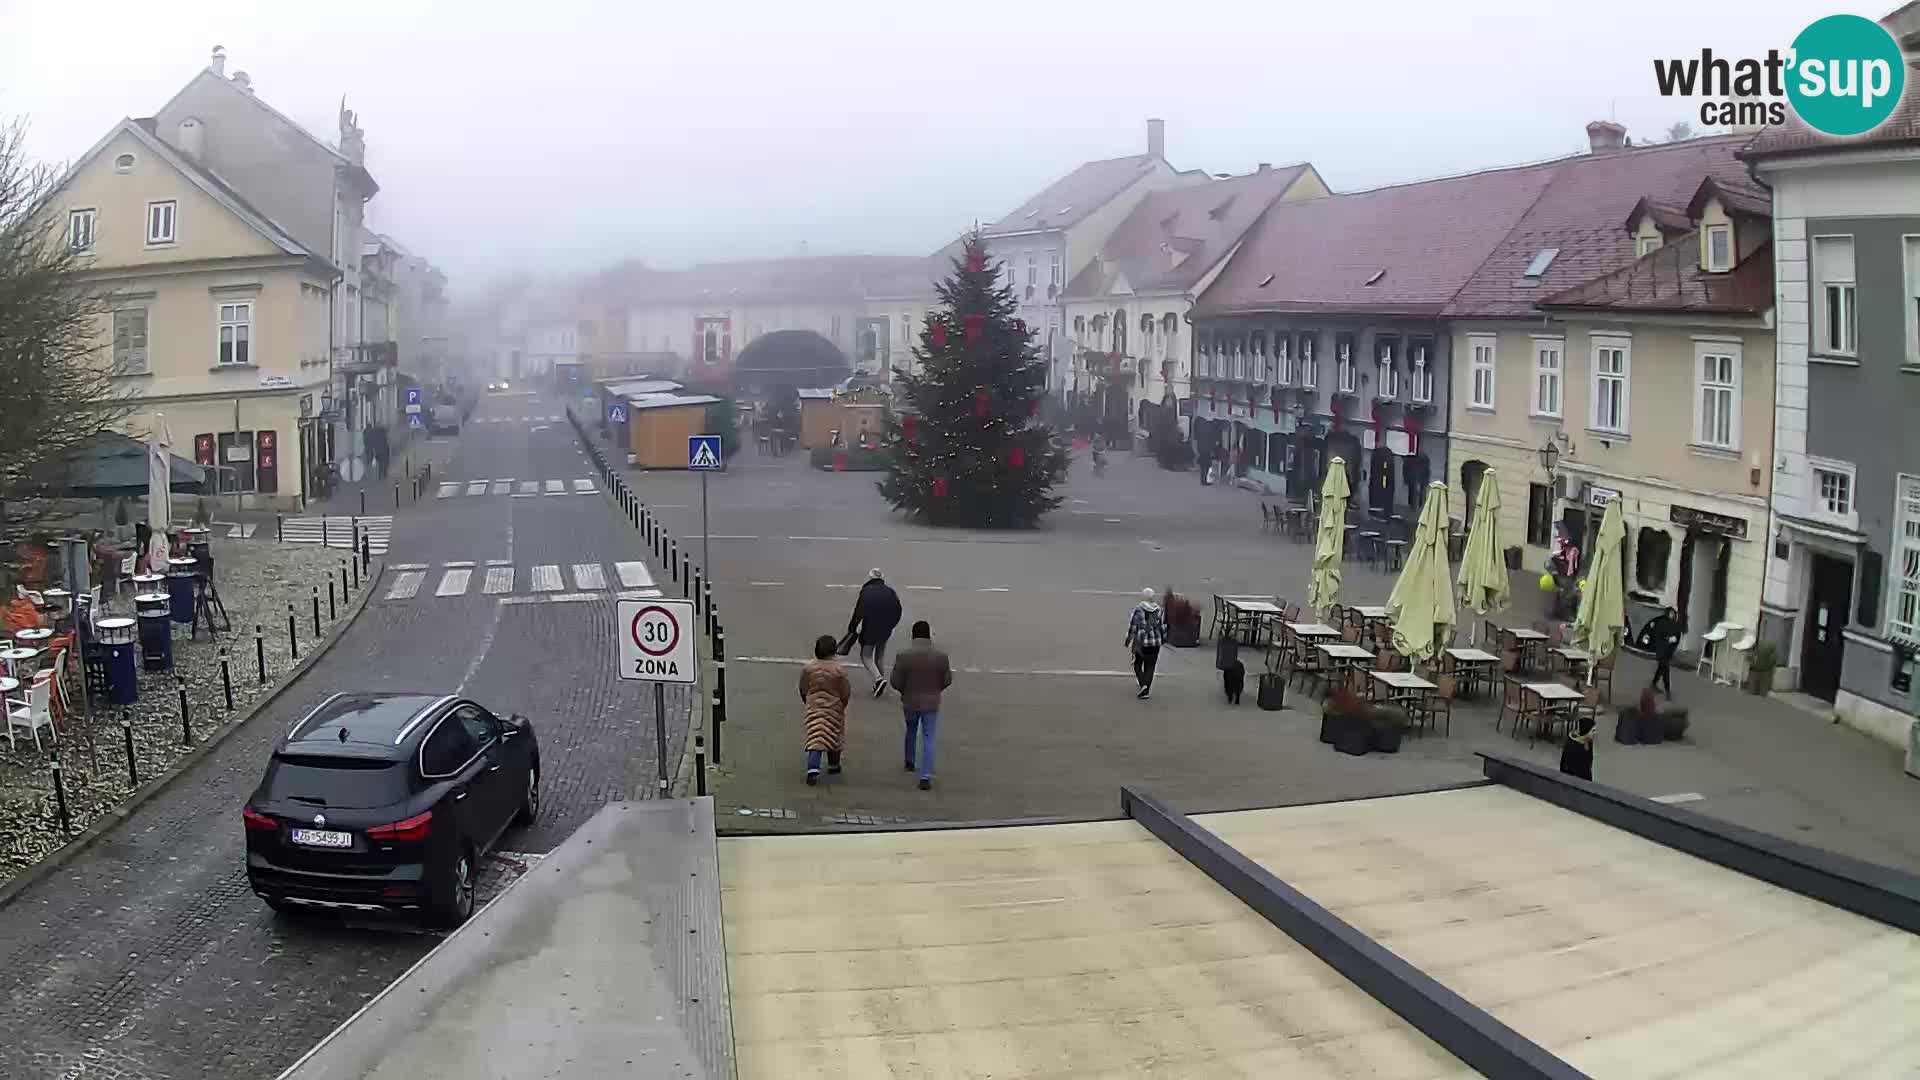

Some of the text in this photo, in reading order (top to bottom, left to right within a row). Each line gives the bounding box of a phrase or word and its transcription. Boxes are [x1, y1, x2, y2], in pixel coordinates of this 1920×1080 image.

[409, 391, 417, 402] P
[644, 621, 668, 642] 30
[634, 658, 679, 675] ZONA
